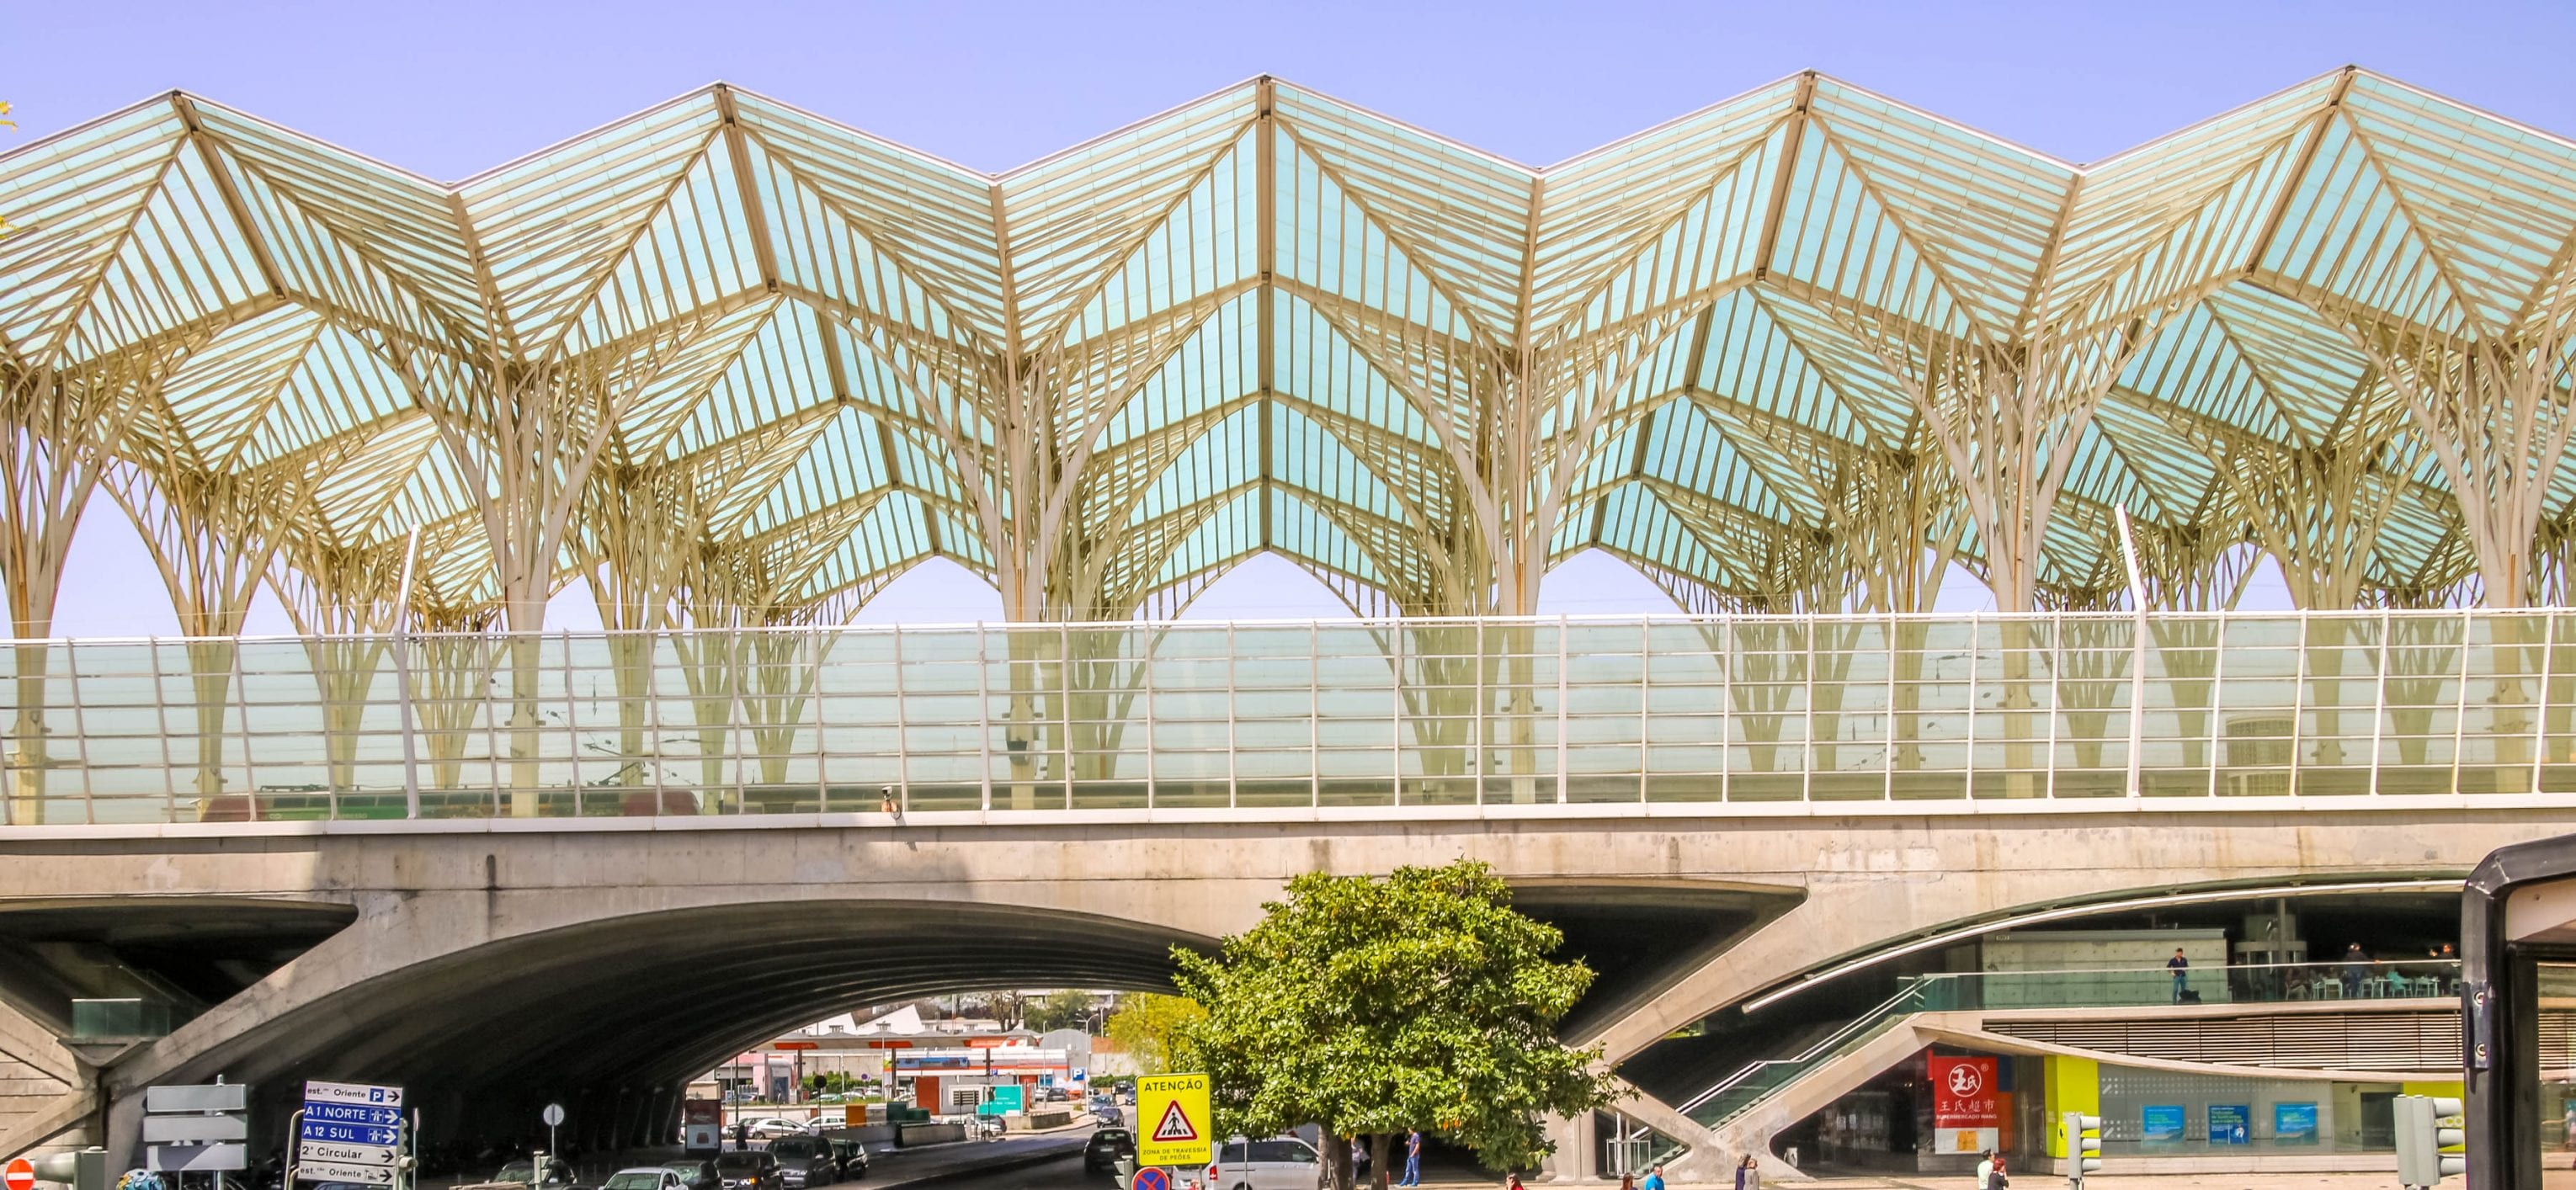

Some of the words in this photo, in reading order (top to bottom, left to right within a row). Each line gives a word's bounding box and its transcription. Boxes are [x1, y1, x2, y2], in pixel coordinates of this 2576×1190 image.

[1144, 1079, 1203, 1092] ATENÇÃO
[333, 1088, 366, 1098] Oriente
[305, 1106, 314, 1116] A
[316, 1107, 321, 1116] 1
[325, 1107, 366, 1120] NORTE
[303, 1125, 311, 1136] A
[315, 1126, 325, 1137] 12
[329, 1127, 355, 1140] SUL
[317, 1147, 363, 1159] Circular
[329, 1168, 362, 1177] Oriente
